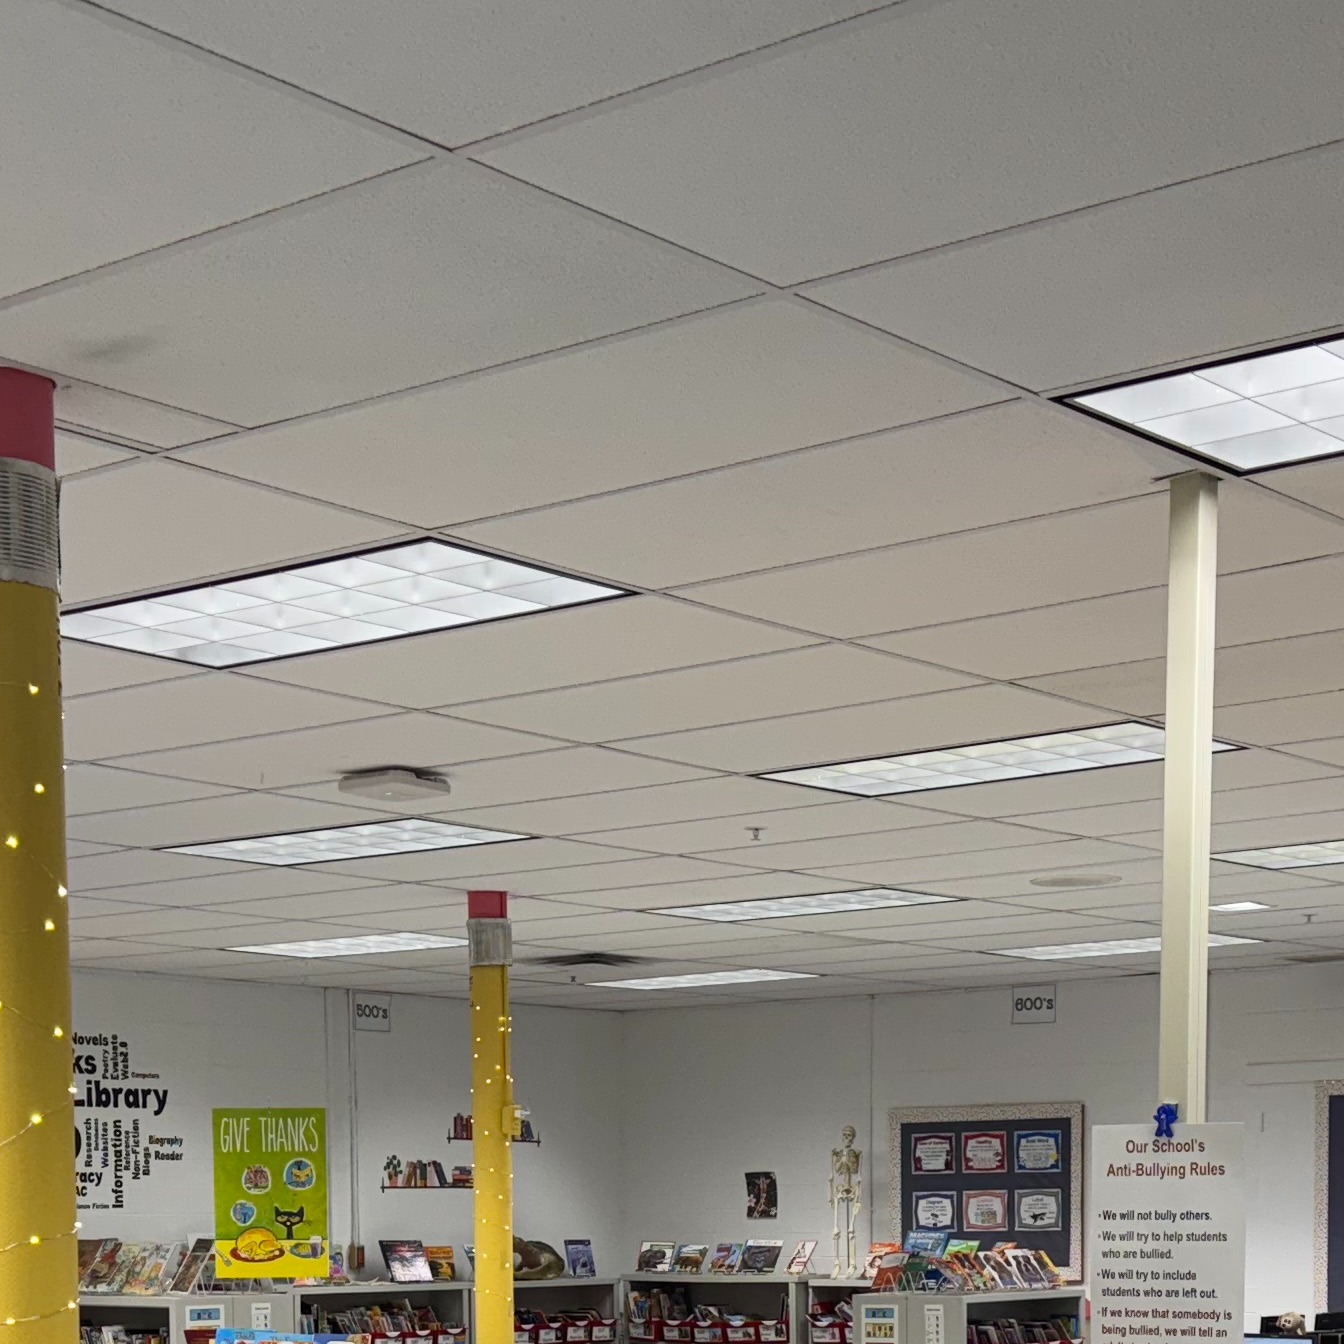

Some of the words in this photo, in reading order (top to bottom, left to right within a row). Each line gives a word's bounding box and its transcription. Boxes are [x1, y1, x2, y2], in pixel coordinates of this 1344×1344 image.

[357, 1004, 388, 1019] 500's
[1015, 997, 1053, 1012] 600's
[221, 1118, 250, 1152] GIVE
[259, 1117, 318, 1152] THANKS
[1126, 1140, 1148, 1153] Our
[1152, 1139, 1205, 1152] School's
[111, 1120, 123, 1208] Information
[1107, 1163, 1185, 1180] Anti-Bullying
[1190, 1162, 1225, 1176] Rules
[1102, 1210, 1116, 1220] We
[1120, 1210, 1134, 1220] will
[1137, 1211, 1152, 1220] not
[1155, 1210, 1177, 1223] bully
[1180, 1211, 1212, 1220] others.
[1102, 1231, 1116, 1241] We
[1119, 1231, 1134, 1241] will
[1137, 1232, 1149, 1244] try
[1152, 1232, 1160, 1241] to
[1164, 1231, 1183, 1244] help
[1186, 1231, 1227, 1241] students
[1102, 1248, 1120, 1258] who
[1123, 1250, 1137, 1259] are
[1140, 1249, 1173, 1259] bullied.
[1101, 1269, 1115, 1279] We
[1118, 1270, 1133, 1279] will
[1136, 1271, 1148, 1282] try
[1151, 1270, 1160, 1279] to
[1163, 1270, 1196, 1280] include
[1102, 1287, 1140, 1296] students
[1143, 1288, 1162, 1297] who
[1165, 1289, 1179, 1297] are
[1182, 1288, 1197, 1298] left
[1102, 1307, 1107, 1317] If
[1110, 1309, 1122, 1317] we
[1125, 1308, 1149, 1318] know
[1152, 1308, 1169, 1318] that
[1172, 1309, 1220, 1322] somebody
[1224, 1310, 1232, 1320] is
[1102, 1324, 1126, 1337] being
[1165, 1328, 1177, 1336] we
[1180, 1326, 1196, 1336] will
[1199, 1327, 1212, 1337] tell
[1216, 1329, 1227, 1337] an
